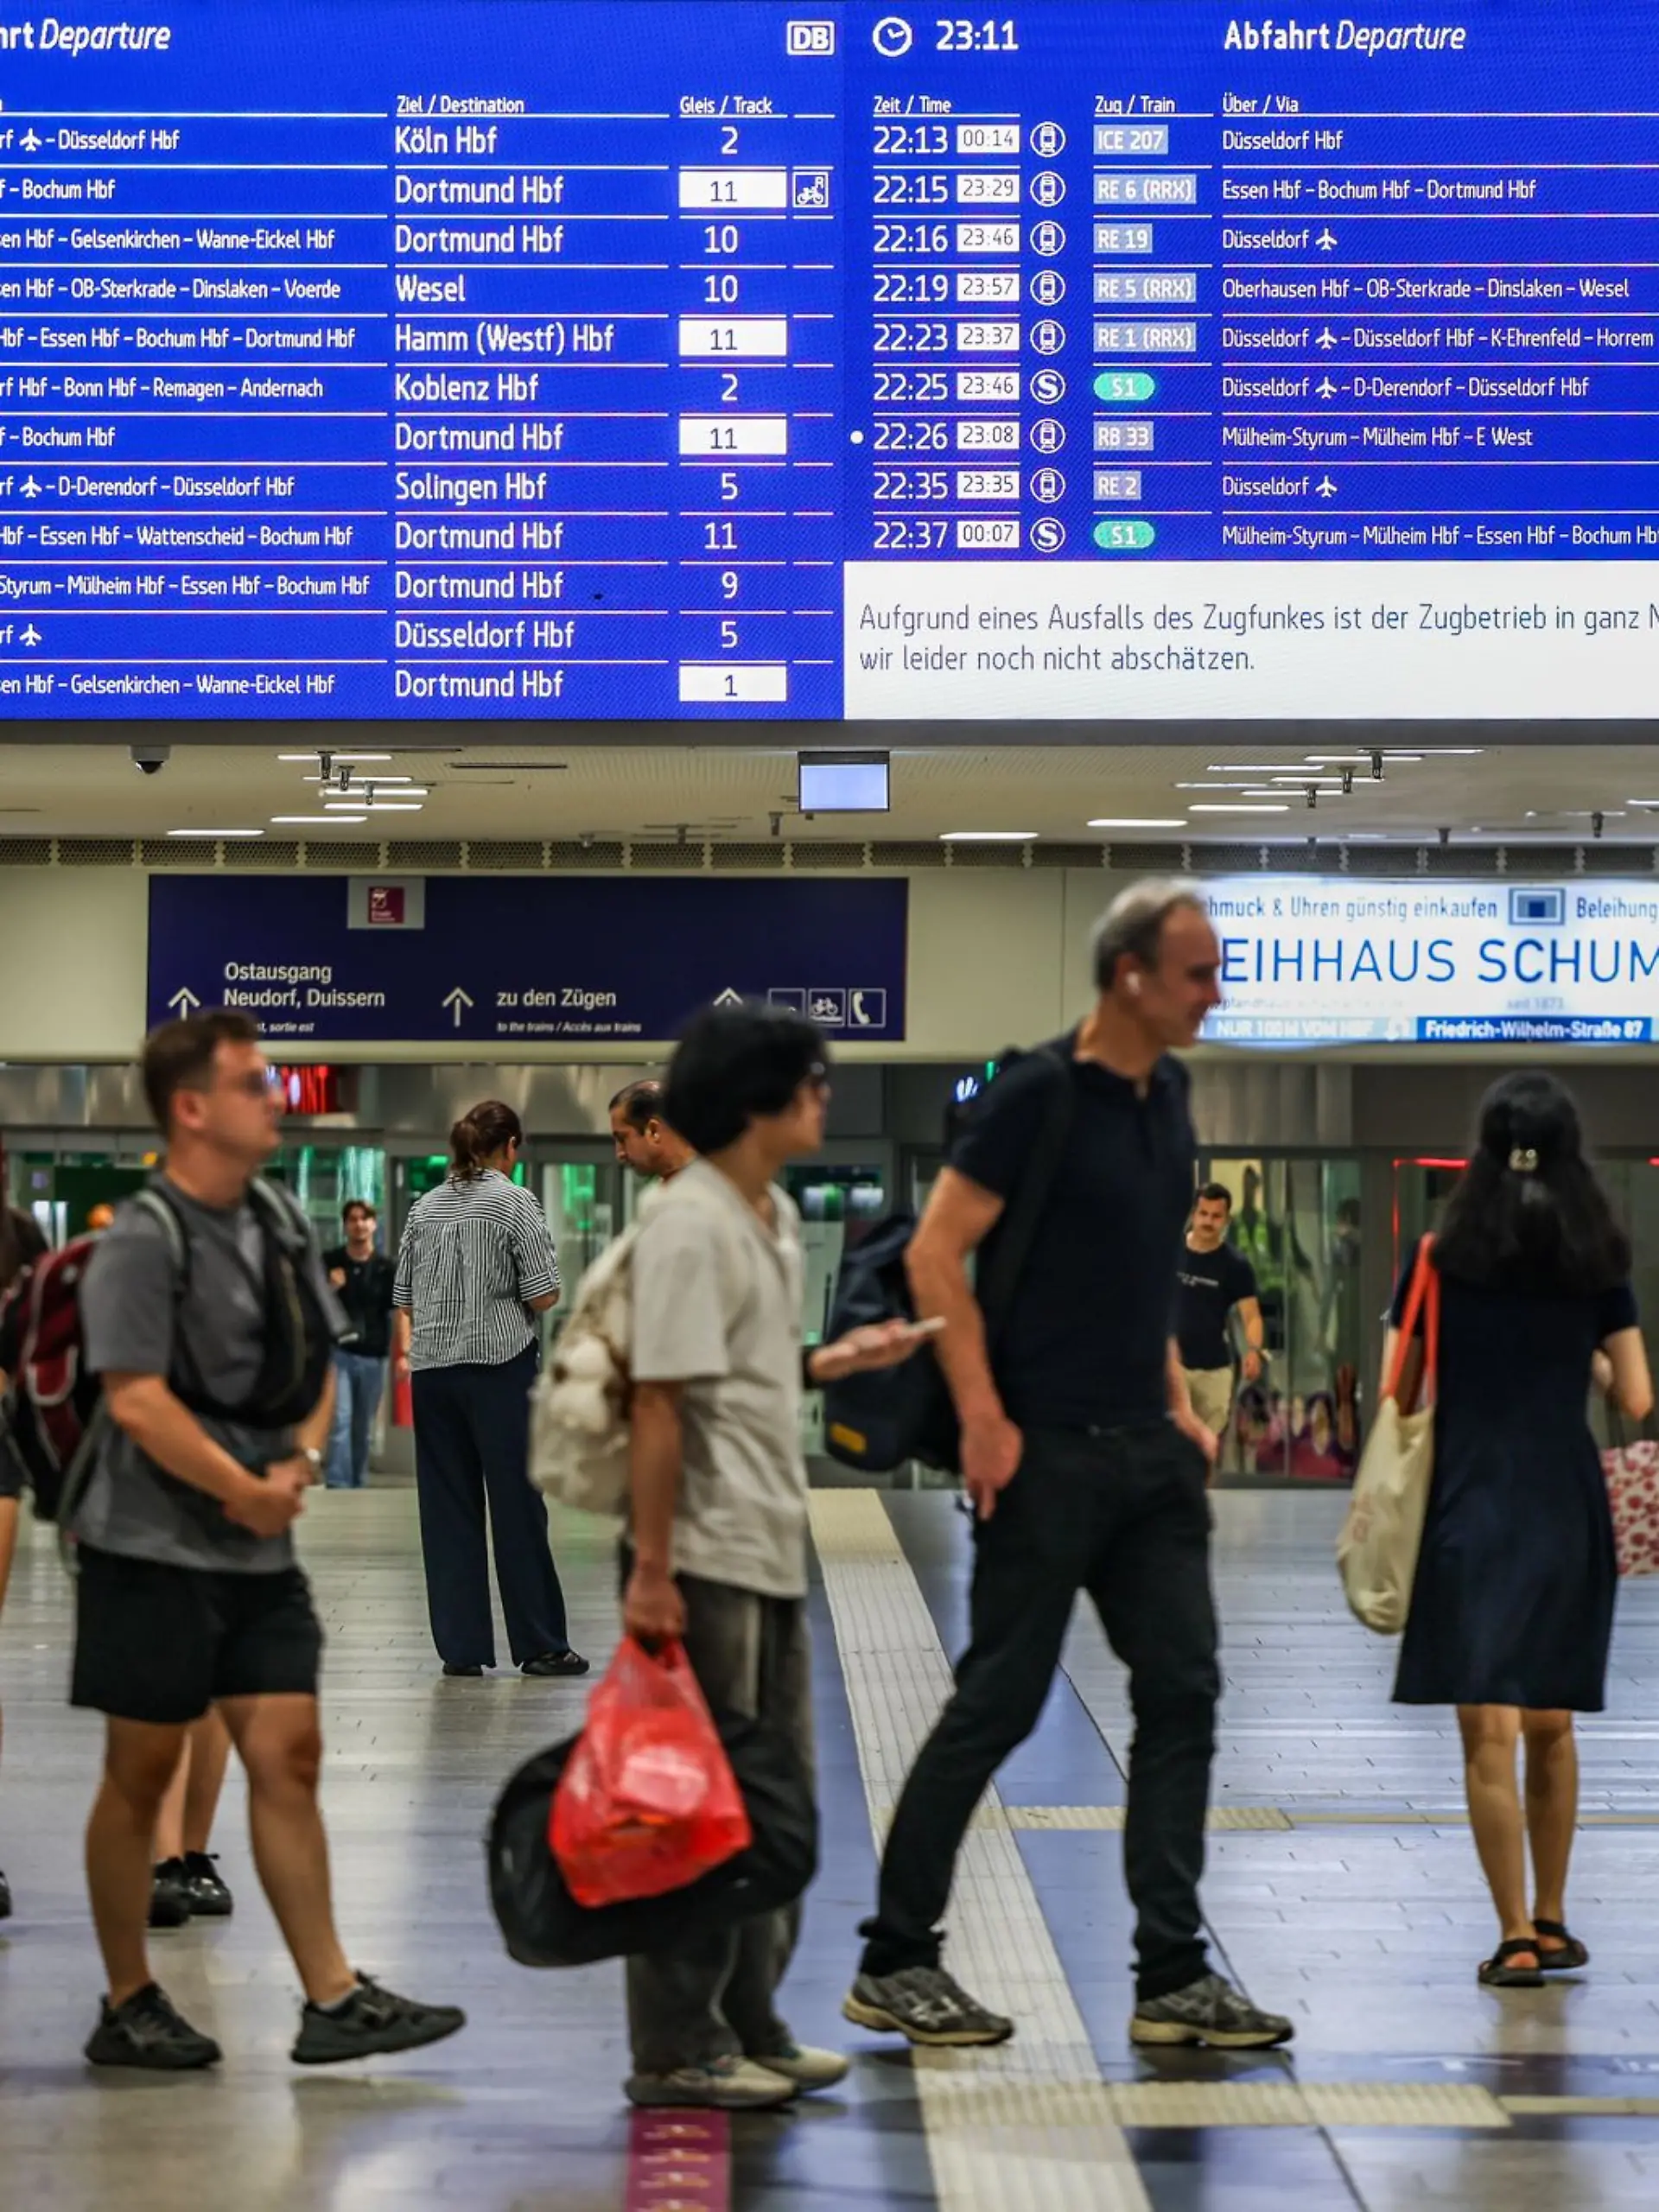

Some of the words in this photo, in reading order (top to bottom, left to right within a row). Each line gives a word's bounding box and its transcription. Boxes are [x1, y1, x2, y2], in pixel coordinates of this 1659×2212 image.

[39, 18, 170, 56] Departure
[790, 24, 832, 53] DB
[937, 20, 1019, 50] 23:11
[1224, 20, 1330, 49] Abfahrt
[1336, 20, 1465, 57] Departure
[397, 95, 423, 112] Ziel
[441, 95, 524, 112] Destination
[680, 96, 715, 112] Gleis
[734, 96, 772, 112] Track
[874, 96, 900, 112] Zeit
[919, 96, 951, 112] Time
[1095, 96, 1122, 115] Zug
[1141, 96, 1175, 112] Train
[1224, 92, 1257, 112] Über
[1276, 96, 1299, 112] Via
[59, 130, 146, 149] Düsseldorf
[151, 130, 180, 149] Hbf
[396, 126, 448, 153] Köln
[456, 126, 497, 153] Hbf
[721, 126, 738, 154] 2
[874, 126, 948, 153] 22:13
[964, 130, 1013, 146] 00:14
[1099, 130, 1123, 149] ICE
[1130, 131, 1163, 149] 207
[1223, 130, 1309, 149] Düsseldorf
[1315, 130, 1343, 149] Hbf
[396, 175, 514, 203] Dortmund
[523, 175, 563, 203] Hbf
[711, 181, 737, 201] 11
[874, 175, 948, 203] 22:15
[963, 180, 1013, 196] 23:29
[1099, 180, 1119, 199] RE
[1126, 181, 1135, 199] 6
[1144, 180, 1192, 200] (RRX)
[26, 229, 54, 248] Hbf
[71, 228, 180, 248] Gelsenkirchen
[196, 229, 301, 249] Wanne-Eickel
[307, 229, 334, 249] Hbf
[874, 225, 948, 252] 22:16
[963, 228, 1013, 245] 23:46
[1098, 230, 1119, 248] RE
[1126, 230, 1147, 248] 19
[26, 278, 54, 297] Hbf
[71, 278, 176, 298] OB-Sterkrade
[193, 278, 268, 298] Dinslaken
[284, 279, 340, 298] Voerde
[396, 274, 466, 302] Wesel
[874, 275, 948, 302] 22:19
[964, 277, 1014, 295] 23:57
[1098, 279, 1119, 297] RE
[1126, 280, 1135, 297] 5
[1144, 278, 1191, 300] (RRX)
[1224, 279, 1316, 298] Oberhausen
[1322, 279, 1350, 297] Hbf
[1367, 278, 1471, 297] OB-Sterkrade
[1489, 278, 1562, 297] Dinslaken
[1580, 278, 1629, 296] Wesel
[396, 324, 467, 351] Hamm
[477, 322, 564, 355] (Westf)
[573, 324, 613, 351] Hbf
[711, 329, 737, 350] 11
[874, 324, 948, 351] 22:23
[963, 327, 1013, 344] 23:37
[1099, 328, 1118, 346] RE
[1126, 328, 1136, 346] 1
[1144, 327, 1191, 349] (RRX)
[1223, 328, 1309, 347] Düsseldorf
[1355, 328, 1440, 346] Düsseldorf
[1446, 328, 1474, 346] Hbf
[1491, 328, 1580, 346] K-Ehrenfeld
[1598, 328, 1653, 346] Horrem
[19, 377, 48, 397] Hbf
[65, 377, 103, 397] Bonn
[109, 378, 137, 397] Hbf
[154, 378, 224, 401] Remagen
[241, 378, 322, 397] Andernach
[395, 373, 489, 401] Koblenz
[498, 373, 538, 401] Hbf
[721, 373, 737, 401] 2
[874, 373, 948, 400] 22:25
[963, 377, 1013, 393] 23:46
[1114, 378, 1135, 396] S1
[874, 423, 948, 449] 22:26
[963, 427, 1013, 442] 23:08
[1099, 428, 1120, 446] RB
[1127, 427, 1148, 446] 33
[1223, 427, 1346, 450] Mülheim-Styrum
[1363, 427, 1426, 446] Mülheim
[1432, 427, 1459, 446] Hbf
[1478, 427, 1485, 445] E
[1491, 428, 1533, 446] West
[59, 476, 157, 496] D-Derendorf
[174, 476, 261, 496] Düsseldorf
[266, 476, 295, 496] Hbf
[396, 472, 497, 505] Solingen
[505, 473, 546, 499] Hbf
[721, 473, 737, 499] 5
[874, 473, 948, 499] 22:35
[963, 476, 1013, 493] 23:35
[1098, 477, 1119, 495] RE
[1126, 477, 1135, 495] 2
[41, 526, 86, 545] Essen
[92, 526, 120, 545] Hbf
[137, 526, 244, 545] Wattenscheid
[261, 526, 320, 545] Bochum
[325, 526, 353, 545] Hbf
[705, 523, 737, 550] 11
[874, 522, 947, 548] 22:37
[963, 525, 1013, 542] 00:07
[1113, 527, 1135, 543] S1
[722, 572, 738, 599] 9
[861, 604, 968, 636] Aufgrund
[980, 607, 1038, 629] eines
[1049, 604, 1143, 629] Ausfalls
[1154, 605, 1192, 629] des
[1204, 604, 1324, 636] Zugfunkes
[1335, 607, 1361, 629] ist
[1372, 604, 1408, 629] der
[1420, 604, 1546, 635] Zugbetrieb
[1557, 606, 1574, 628] in
[1585, 612, 1638, 635] ganz
[861, 648, 893, 670] wir
[904, 645, 967, 670] leider
[978, 645, 1033, 670] noch
[1045, 645, 1101, 670] nicht
[1111, 645, 1254, 670] abschätzen.
[726, 675, 737, 696] 1
[1210, 897, 1265, 918] hmuck
[1273, 897, 1283, 917] &
[1291, 897, 1339, 917] Uhren
[1346, 896, 1407, 922] günstig
[1414, 896, 1497, 918] einkaufen
[1221, 938, 1455, 983] EIHHAUS
[225, 962, 332, 983] Ostausgang
[223, 988, 301, 1009] Neudorf,
[307, 988, 385, 1007] Duissern
[497, 991, 518, 1007] zu
[523, 988, 556, 1007] den
[561, 988, 616, 1011] Zügen
[527, 1022, 554, 1033] trains
[614, 1022, 642, 1033] trains
[1425, 1020, 1622, 1039] Friedrich-Wilhelm-Straße
